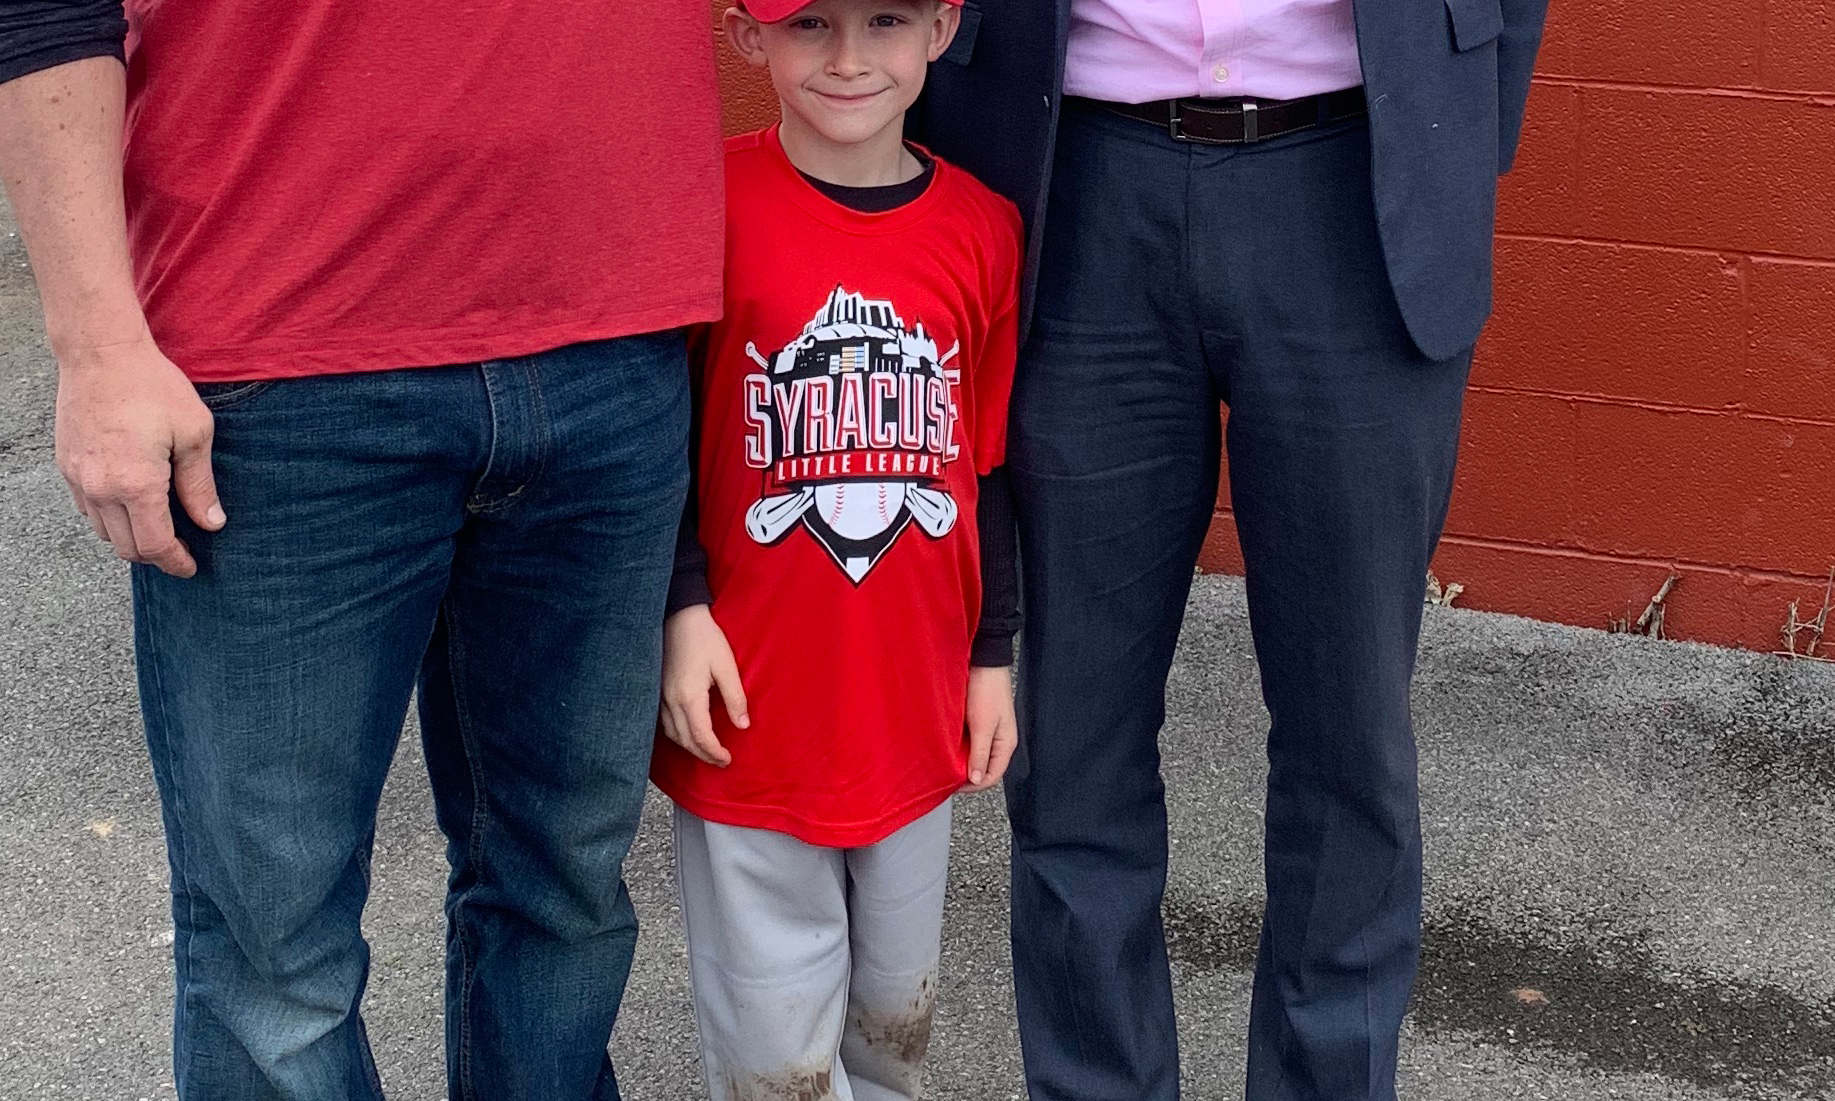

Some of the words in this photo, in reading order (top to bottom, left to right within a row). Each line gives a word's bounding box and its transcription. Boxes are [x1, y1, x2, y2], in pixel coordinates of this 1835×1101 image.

[744, 368, 961, 469] SYRACUSE
[778, 455, 852, 481] LITTLE
[864, 454, 941, 476] LEAGUE
